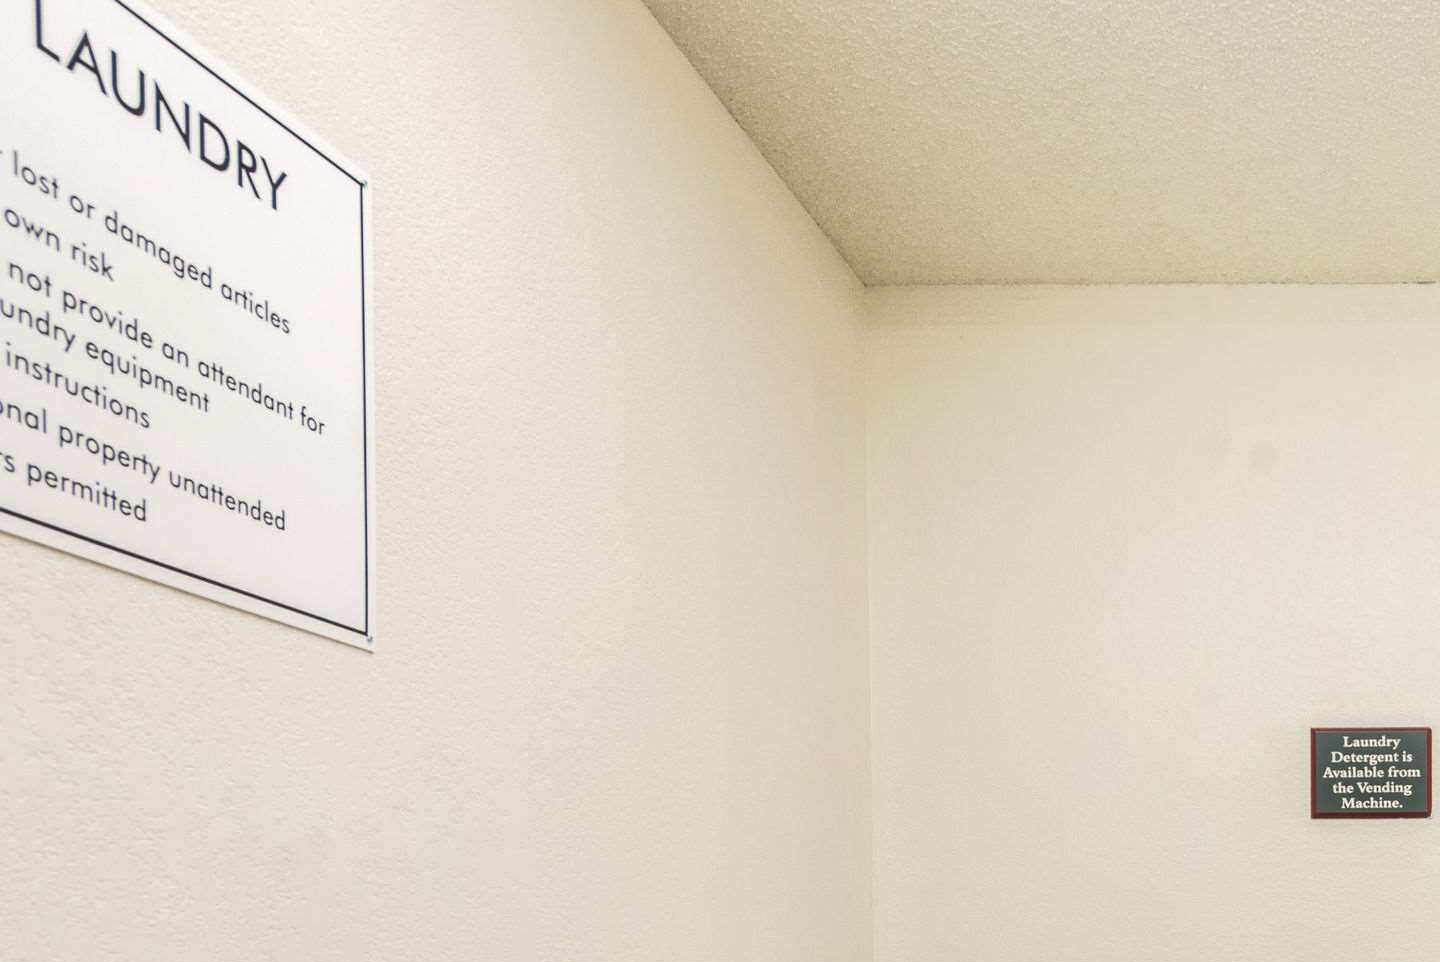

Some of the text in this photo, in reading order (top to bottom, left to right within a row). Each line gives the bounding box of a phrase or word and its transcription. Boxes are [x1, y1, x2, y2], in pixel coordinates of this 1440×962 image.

[35, 0, 288, 211] LAUNDRY
[4, 207, 114, 282] own risk
[12, 150, 292, 334] lost or damaged articles
[9, 261, 326, 436] not provide an attendant for
[85, 341, 210, 413] equipment
[5, 342, 152, 430] instructions
[0, 402, 287, 532] nal property unattended
[27, 462, 148, 523] permitted
[1322, 765, 1421, 779] Available from
[1331, 750, 1413, 766] Detergent is
[1343, 735, 1401, 750] Laundry
[1332, 781, 1413, 797] the Vending
[1341, 796, 1404, 809] Machine.
